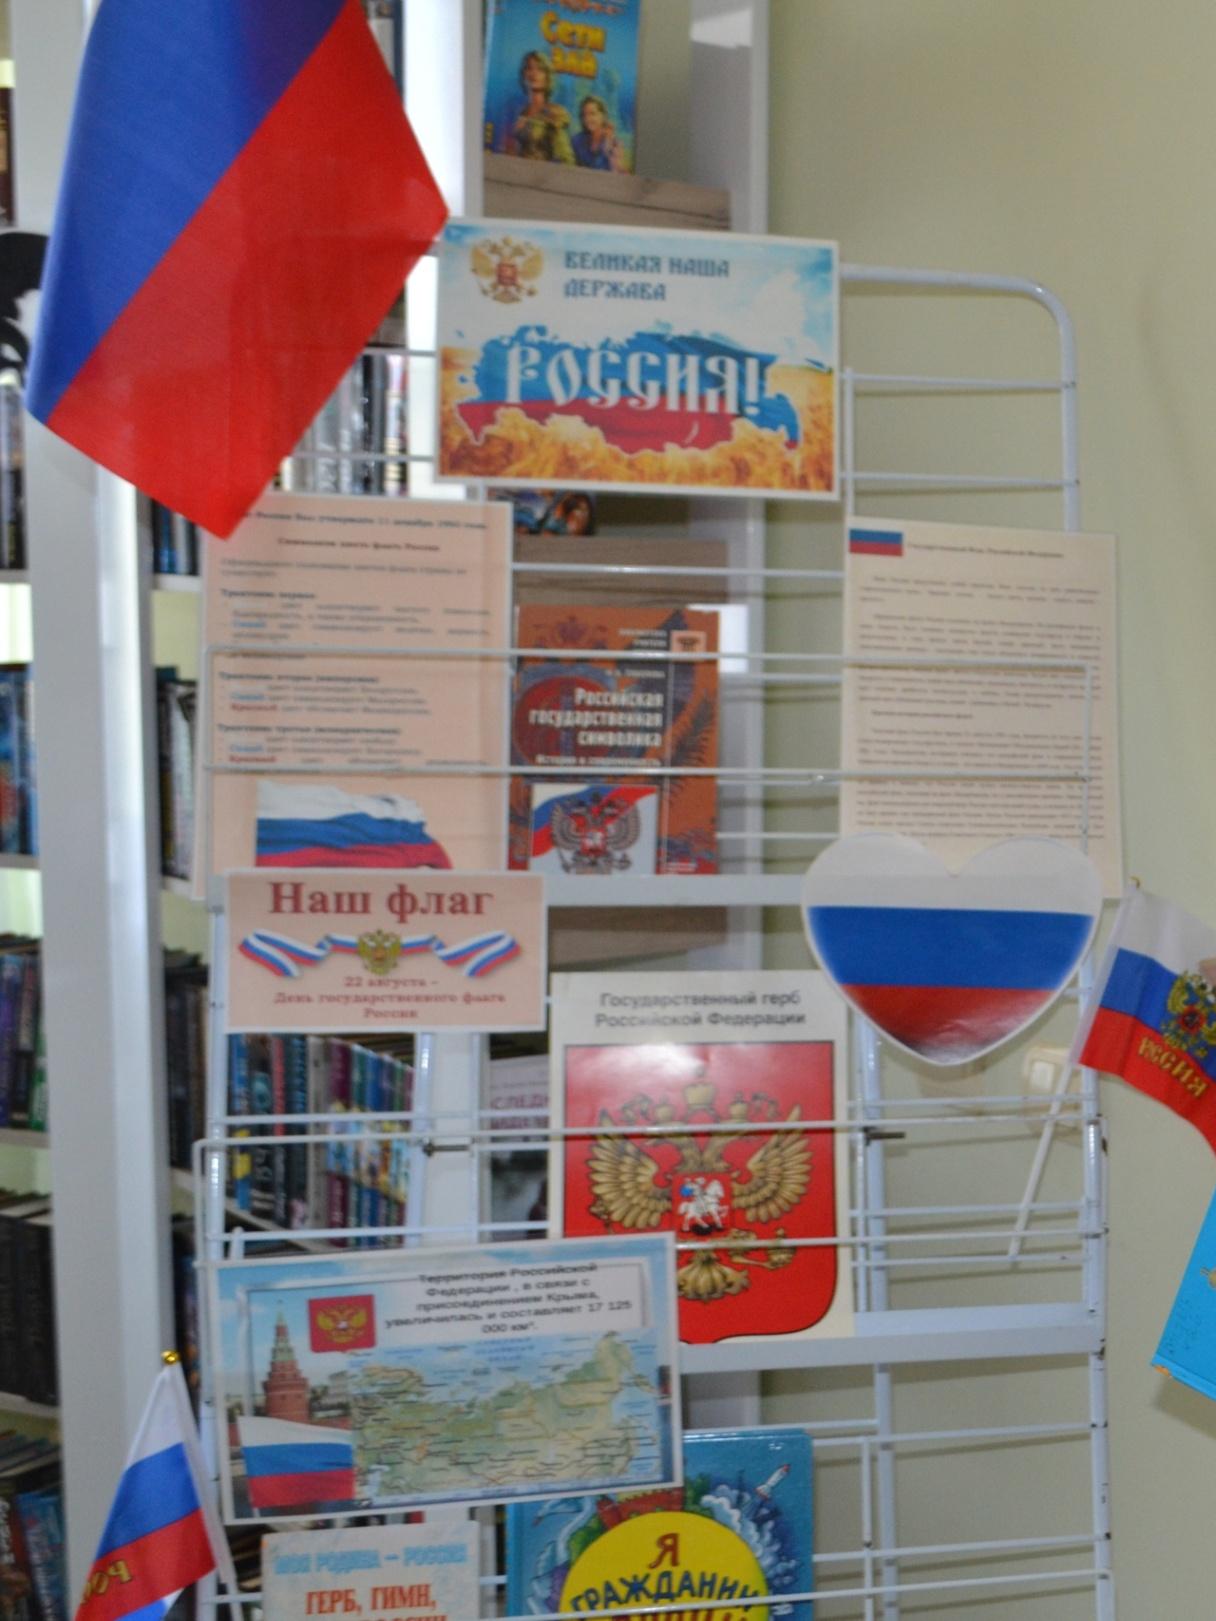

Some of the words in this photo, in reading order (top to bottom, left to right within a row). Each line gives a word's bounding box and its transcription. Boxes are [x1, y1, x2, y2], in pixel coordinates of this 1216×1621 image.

[564, 250, 662, 274] ВЕЛИКАЯ
[668, 257, 730, 278] НАША
[563, 277, 667, 301] ДЕРЖАВА
[504, 344, 761, 416] РОССИЯ!
[574, 687, 664, 707] Российская
[529, 709, 663, 728] государственная
[577, 730, 662, 747] символика
[268, 881, 372, 914] Наш
[386, 883, 494, 923] флаг
[343, 976, 363, 988] 22
[368, 976, 427, 989] августа
[273, 992, 313, 1005] День
[318, 992, 458, 1006] государственного
[462, 992, 506, 1005] флага
[600, 991, 756, 1009] Государственный
[761, 989, 801, 1006] герб
[362, 1007, 419, 1019] России
[595, 1012, 702, 1028] Российской
[707, 1011, 806, 1027] Федерации
[417, 1268, 507, 1284] Территория
[509, 1262, 598, 1277] Российской
[426, 1283, 511, 1298] Федерации
[648, 1532, 680, 1569] Я
[305, 1588, 362, 1616] ГЕРБ,
[370, 1582, 437, 1611] ГИМН,
